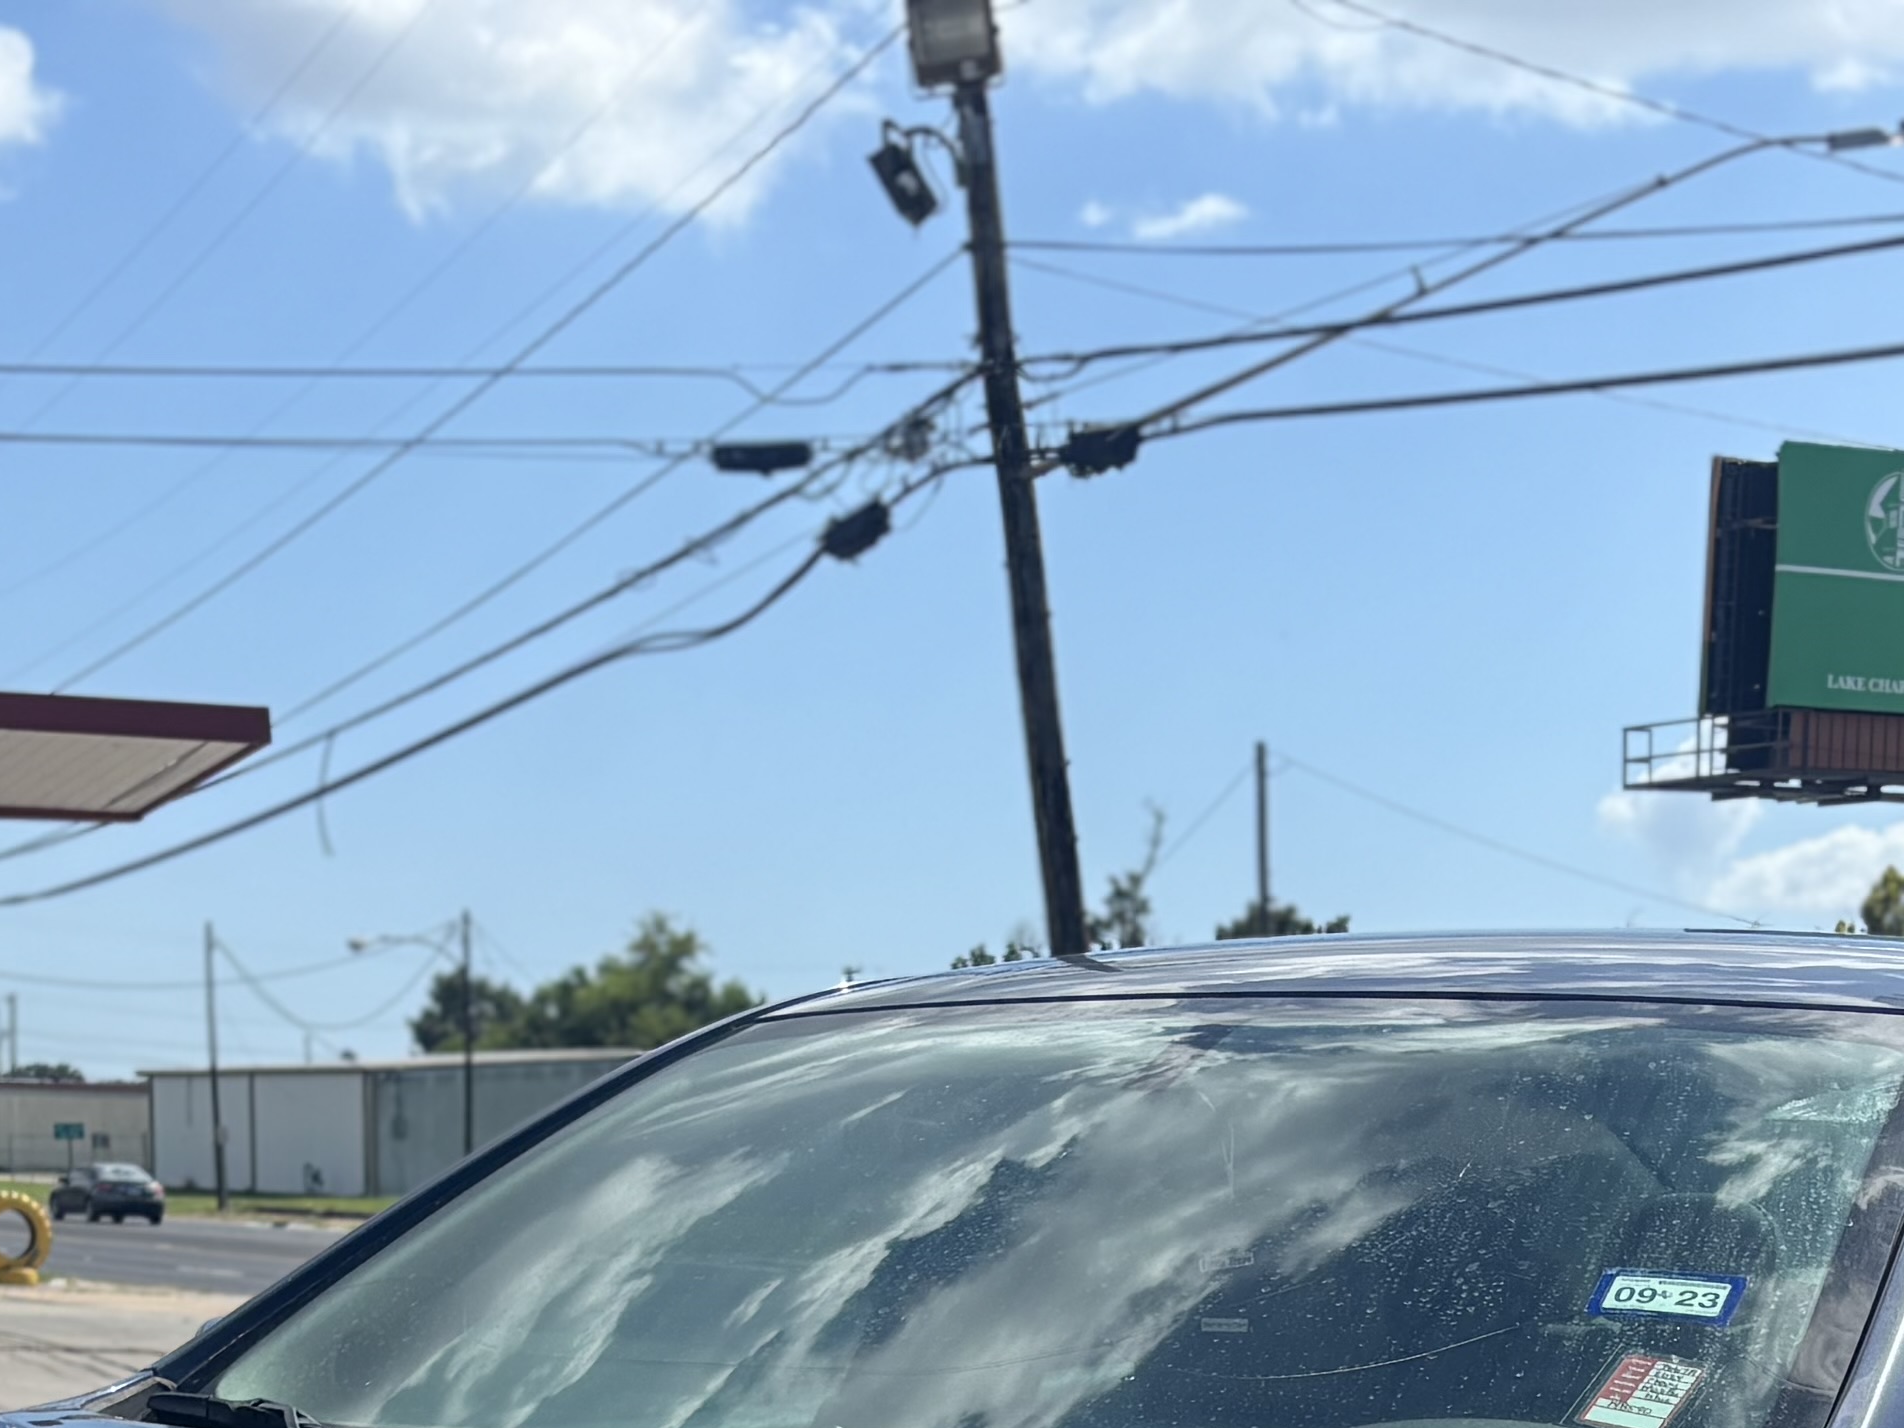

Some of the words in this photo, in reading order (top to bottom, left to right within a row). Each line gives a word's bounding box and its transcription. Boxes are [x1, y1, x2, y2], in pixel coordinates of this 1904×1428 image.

[1827, 674, 1866, 692] LAKE
[1613, 1286, 1658, 1304] 09
[1673, 1290, 1721, 1309] 23
